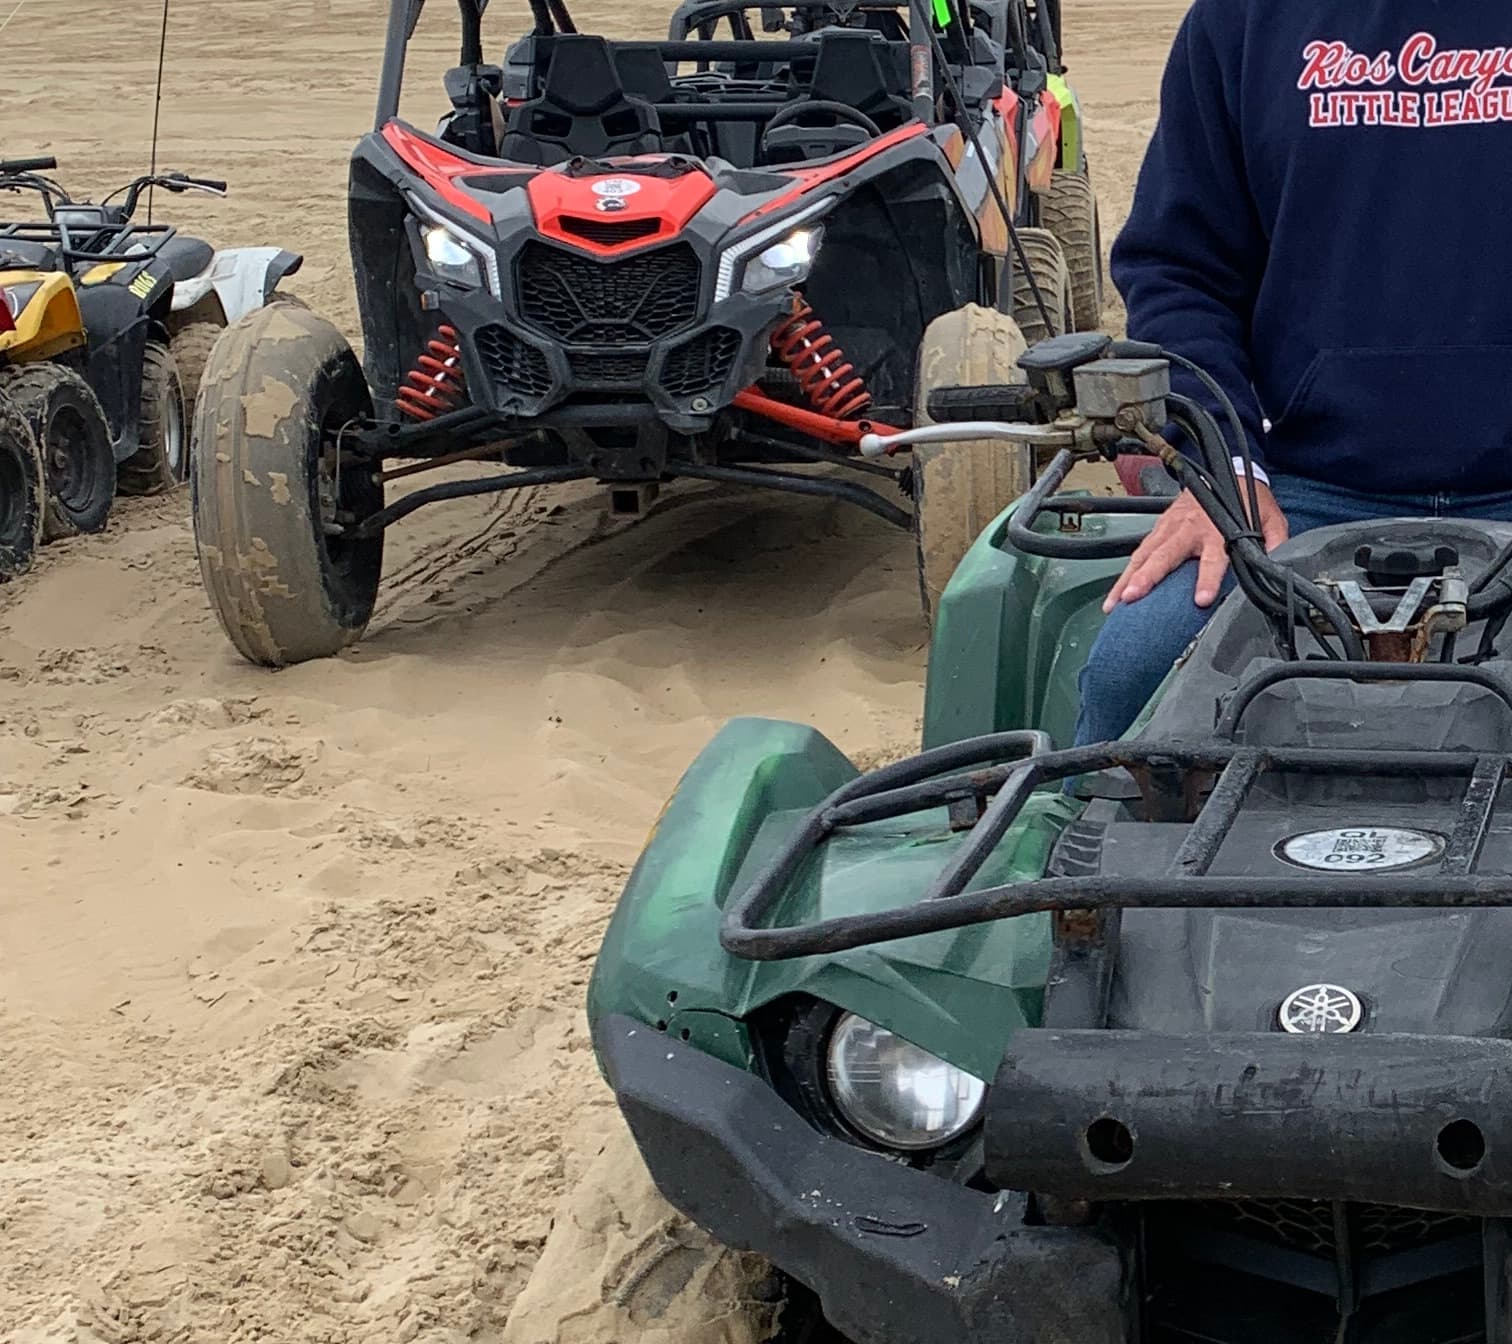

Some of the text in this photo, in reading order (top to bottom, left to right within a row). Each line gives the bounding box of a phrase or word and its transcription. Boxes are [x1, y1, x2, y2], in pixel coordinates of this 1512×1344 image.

[1297, 40, 1394, 90] Rios
[1309, 91, 1420, 127] LITTLE
[1324, 853, 1386, 864] 092
